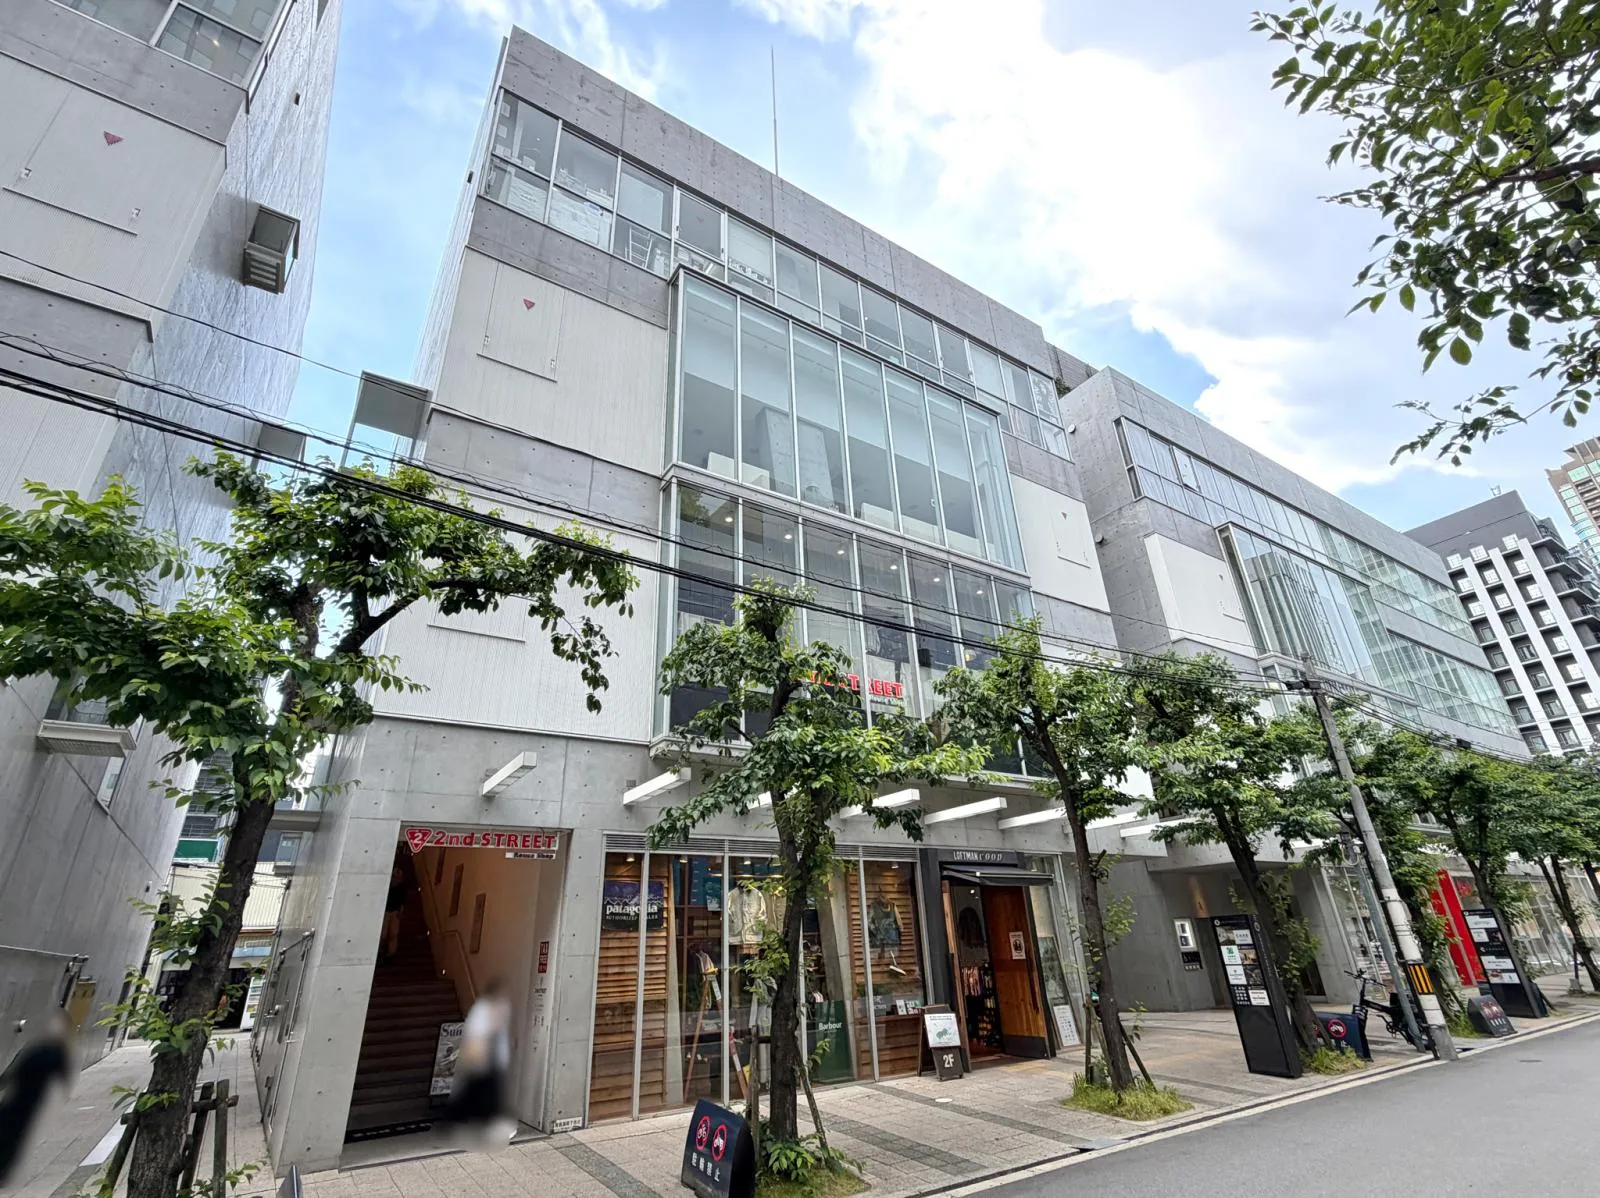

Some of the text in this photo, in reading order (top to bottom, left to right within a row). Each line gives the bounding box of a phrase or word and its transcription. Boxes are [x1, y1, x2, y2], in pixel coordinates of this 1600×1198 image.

[434, 831, 556, 849] 2nd STREET
[953, 851, 978, 861] LOFTMAN
[606, 903, 658, 916] patagoia
[818, 1021, 842, 1031] Barbour
[942, 1053, 954, 1068] 2F
